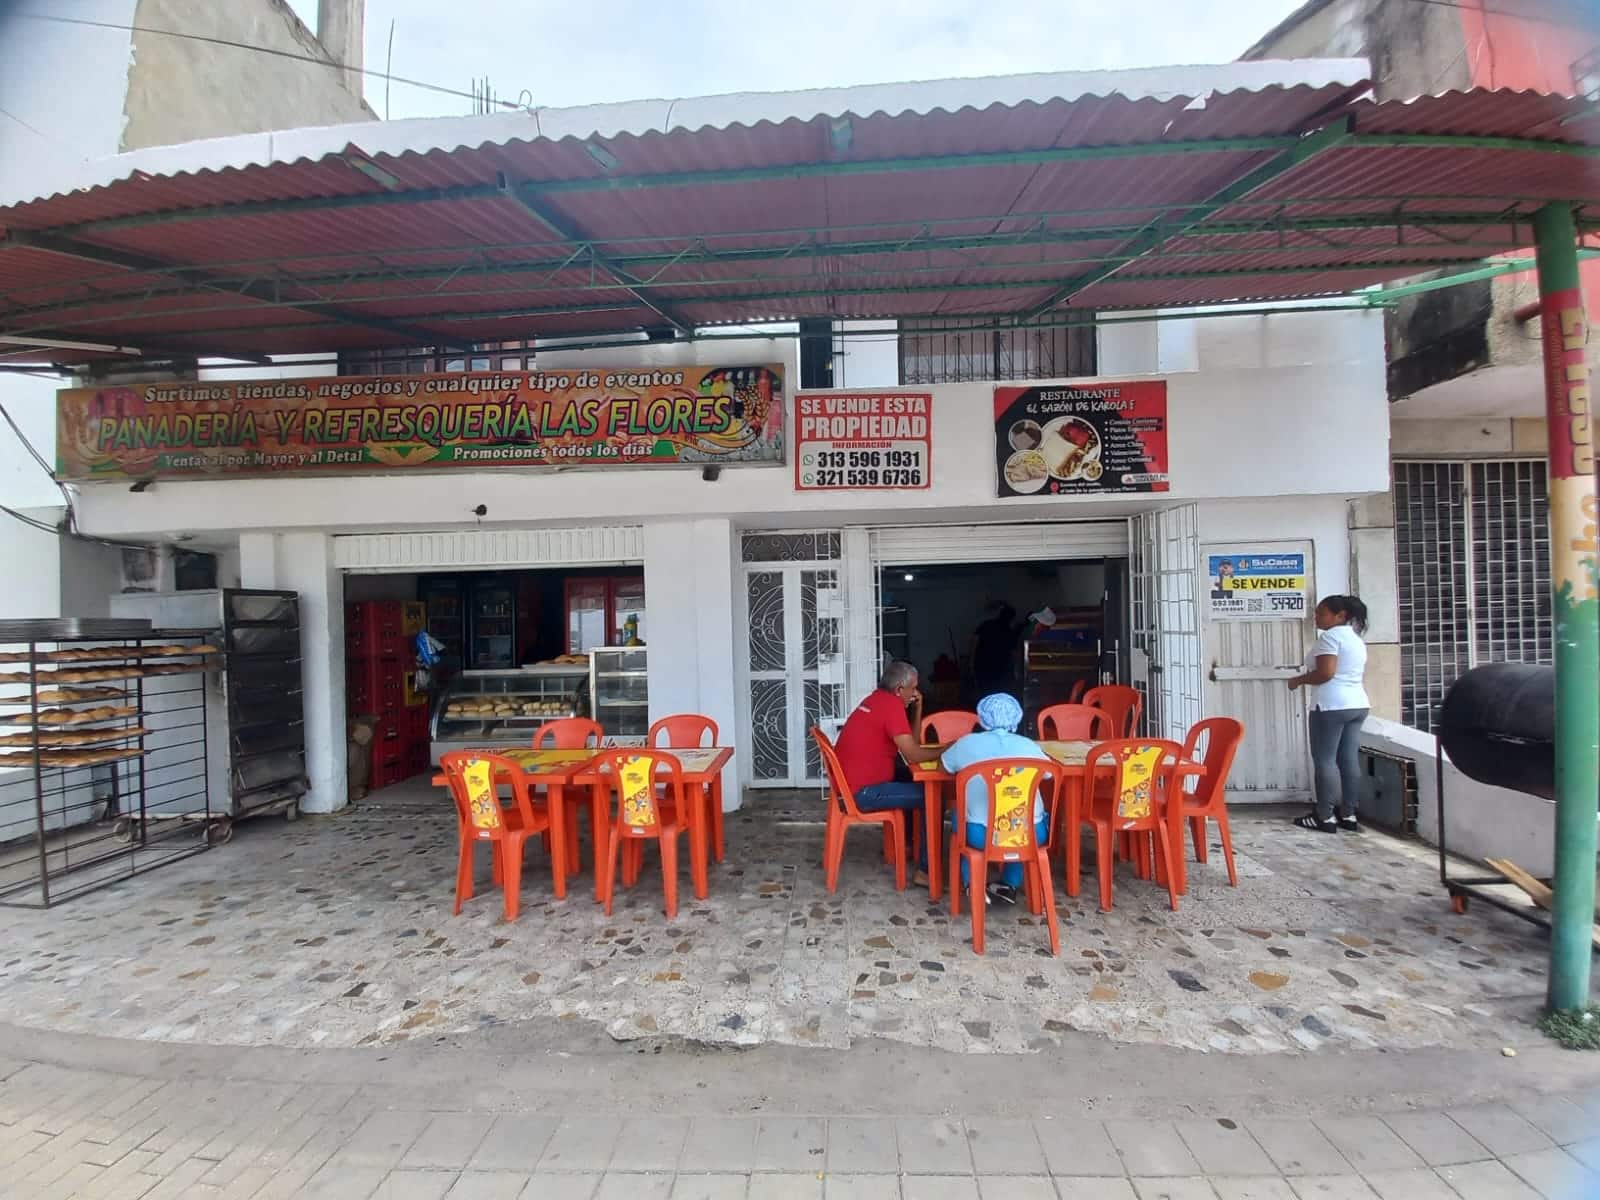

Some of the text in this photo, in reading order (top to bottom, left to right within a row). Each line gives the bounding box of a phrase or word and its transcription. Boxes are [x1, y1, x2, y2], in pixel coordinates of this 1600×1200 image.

[144, 370, 683, 403] Surtimos tiendas, negocios y cualquier tipo de eventos
[1040, 388, 1121, 401] RESTAURANTE
[800, 397, 927, 415] SE VENDE ESTA
[1026, 403, 1038, 414] EL
[1041, 401, 1073, 413] SAZÓN
[1075, 401, 1089, 412] DE
[1091, 400, 1128, 412] KAROLA
[98, 395, 732, 451] PANADERÍA Y REFRESQUERÍA LAS FLORES
[801, 416, 928, 440] PROPIEDAD
[164, 454, 208, 468] Ventas
[227, 454, 249, 469] por
[255, 452, 294, 468] Mayor
[296, 454, 307, 466] y
[309, 451, 323, 463] al
[327, 449, 363, 463] Detal
[453, 446, 547, 460] Promociones
[551, 444, 592, 457] todos
[597, 444, 619, 456] los
[817, 451, 920, 468] 313 596 1931
[816, 469, 922, 486] 321 539 6736
[1232, 578, 1296, 589] SE VENDE
